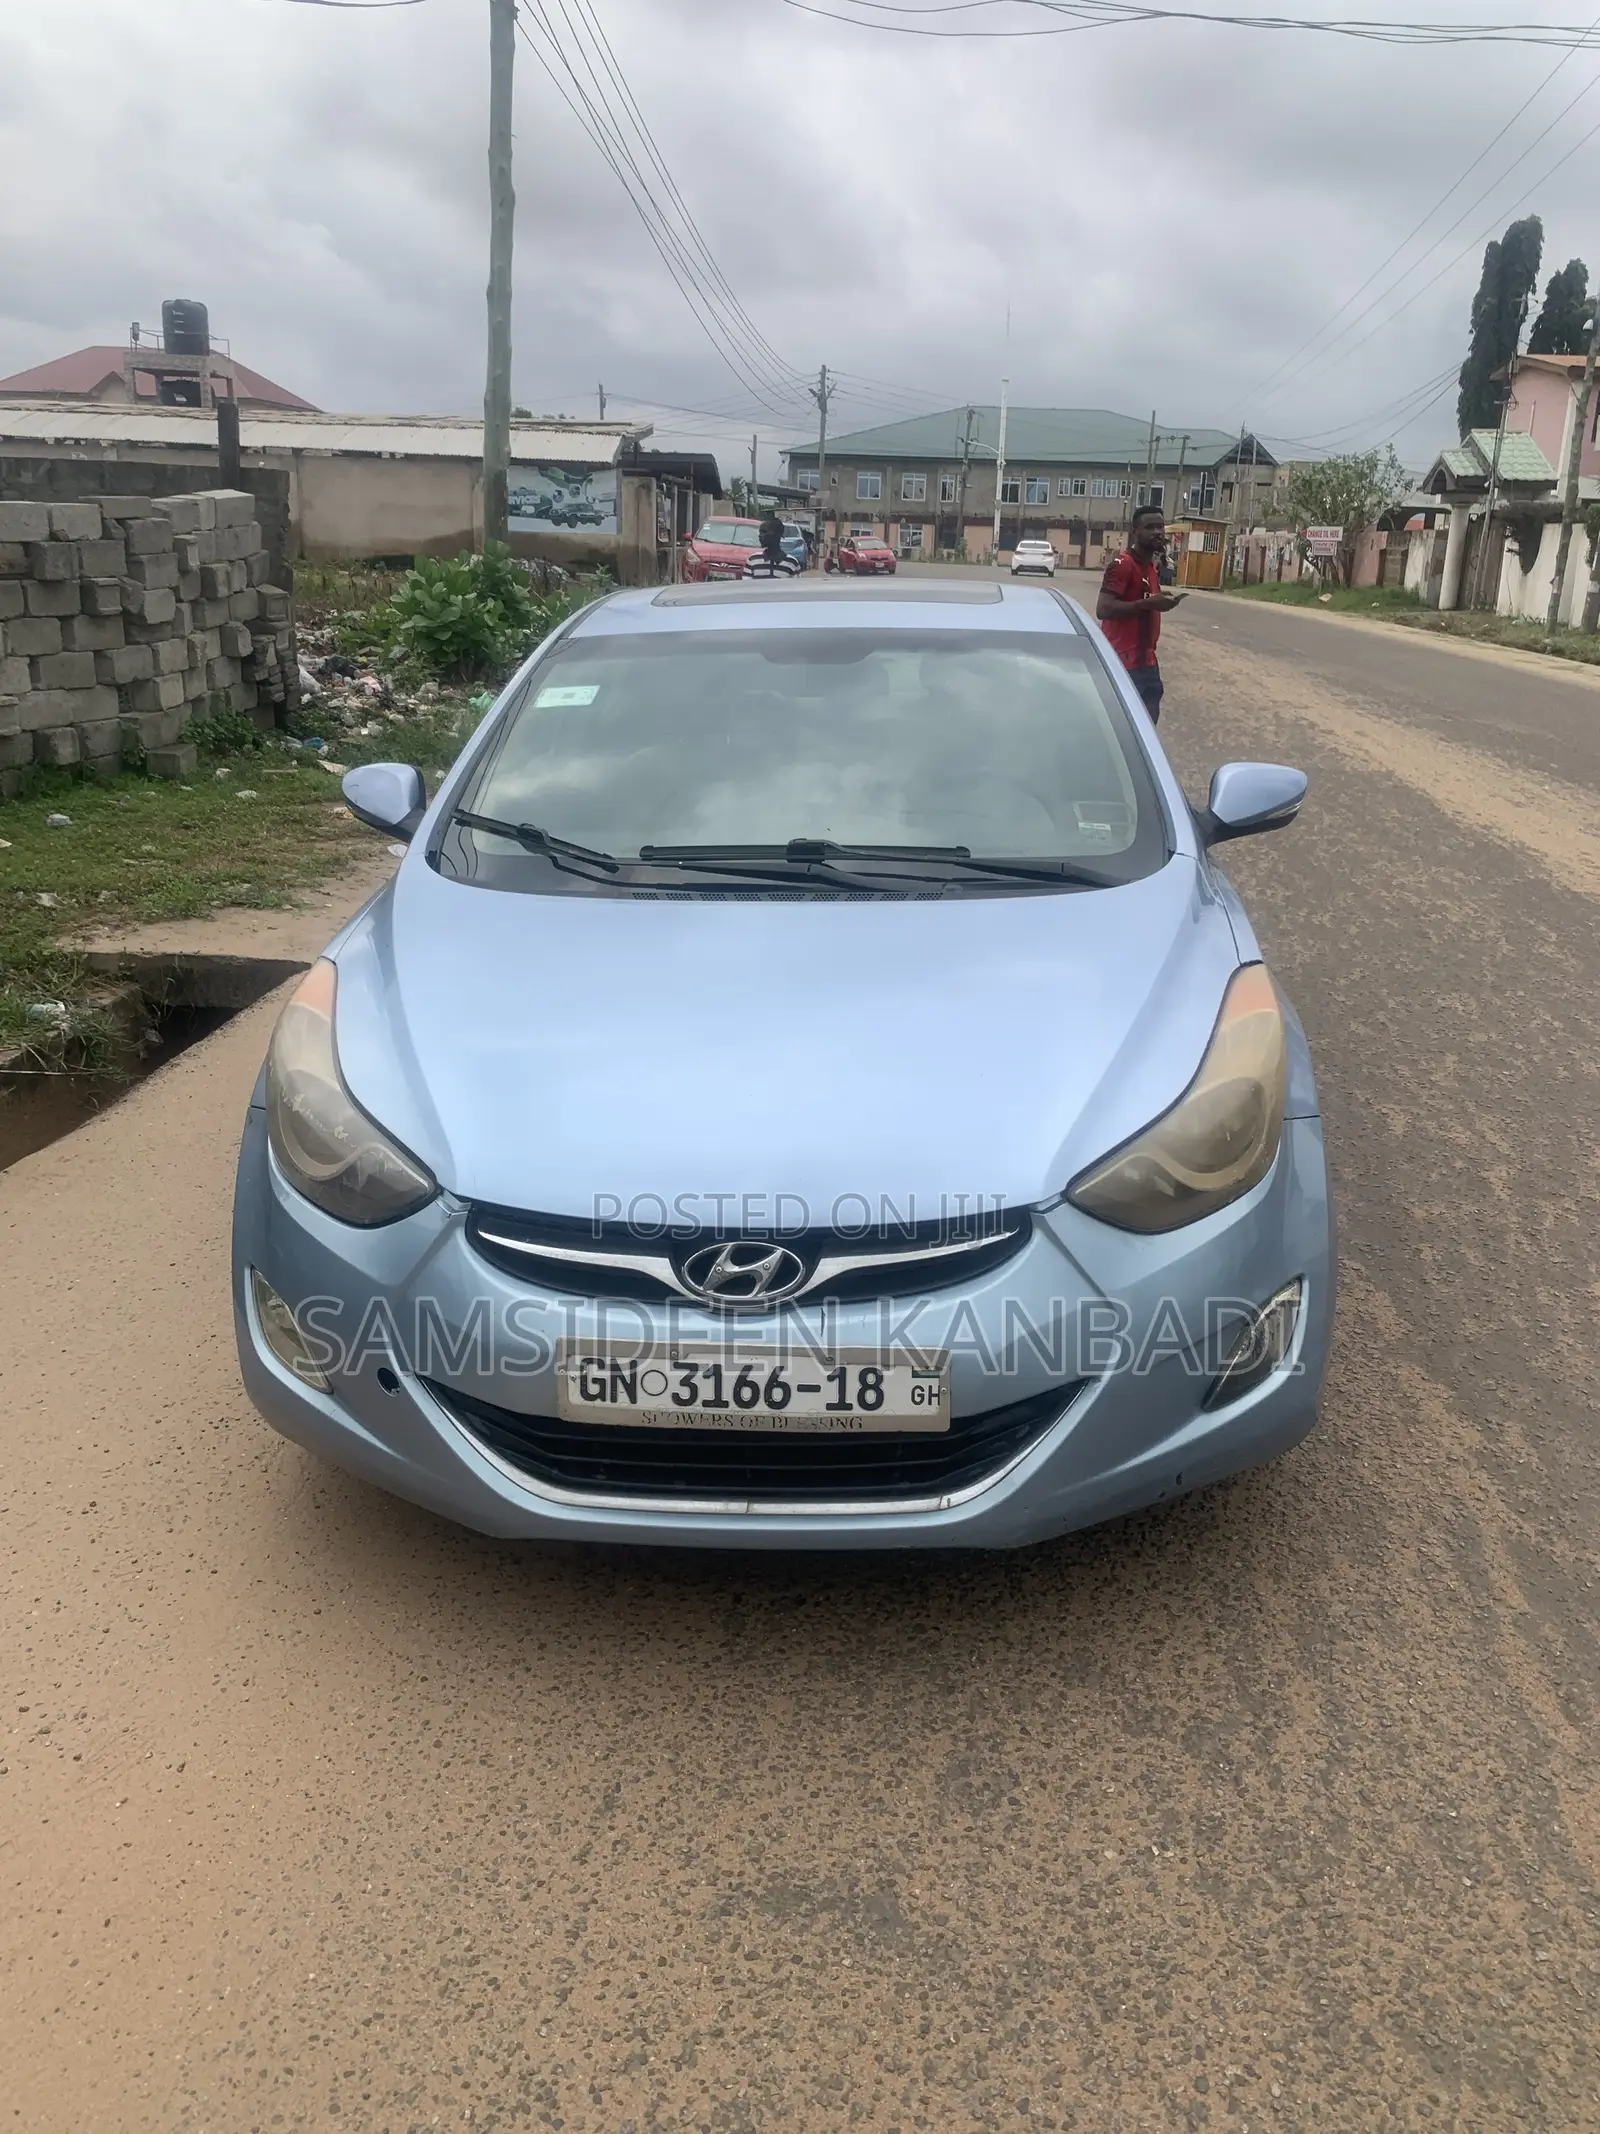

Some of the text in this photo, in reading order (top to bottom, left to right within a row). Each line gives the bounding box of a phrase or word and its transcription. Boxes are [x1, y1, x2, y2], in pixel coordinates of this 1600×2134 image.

[579, 1356, 885, 1412] GN 3166-18
[911, 1384, 940, 1405] GH
